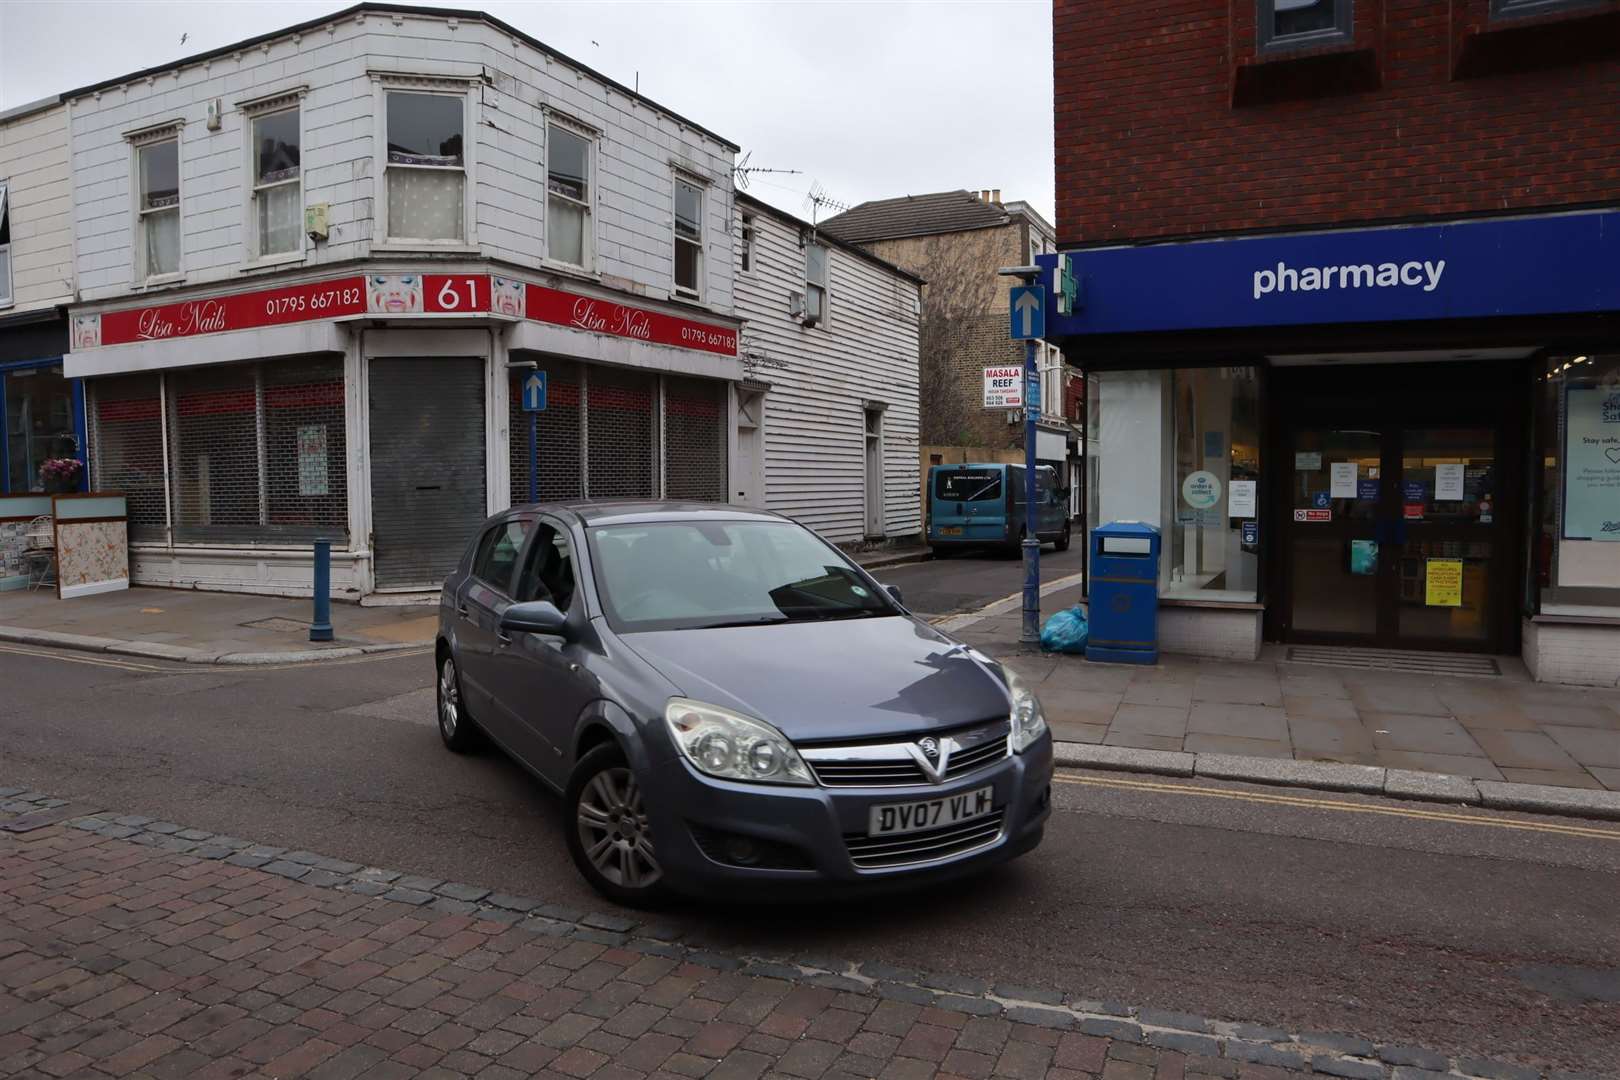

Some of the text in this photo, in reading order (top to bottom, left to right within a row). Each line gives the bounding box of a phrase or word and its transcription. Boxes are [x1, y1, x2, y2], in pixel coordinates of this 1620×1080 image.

[1254, 260, 1445, 299] pharmacy
[266, 288, 359, 315] 01795 667182
[438, 279, 477, 310] 61
[136, 300, 226, 339] Lisa Nails
[570, 298, 650, 339] Lisa Nails
[681, 327, 736, 349] 01795 667182
[986, 369, 1019, 378] MASALA
[993, 379, 1013, 388] REEF
[1583, 437, 1600, 445] Stay
[880, 800, 944, 832] DV07
